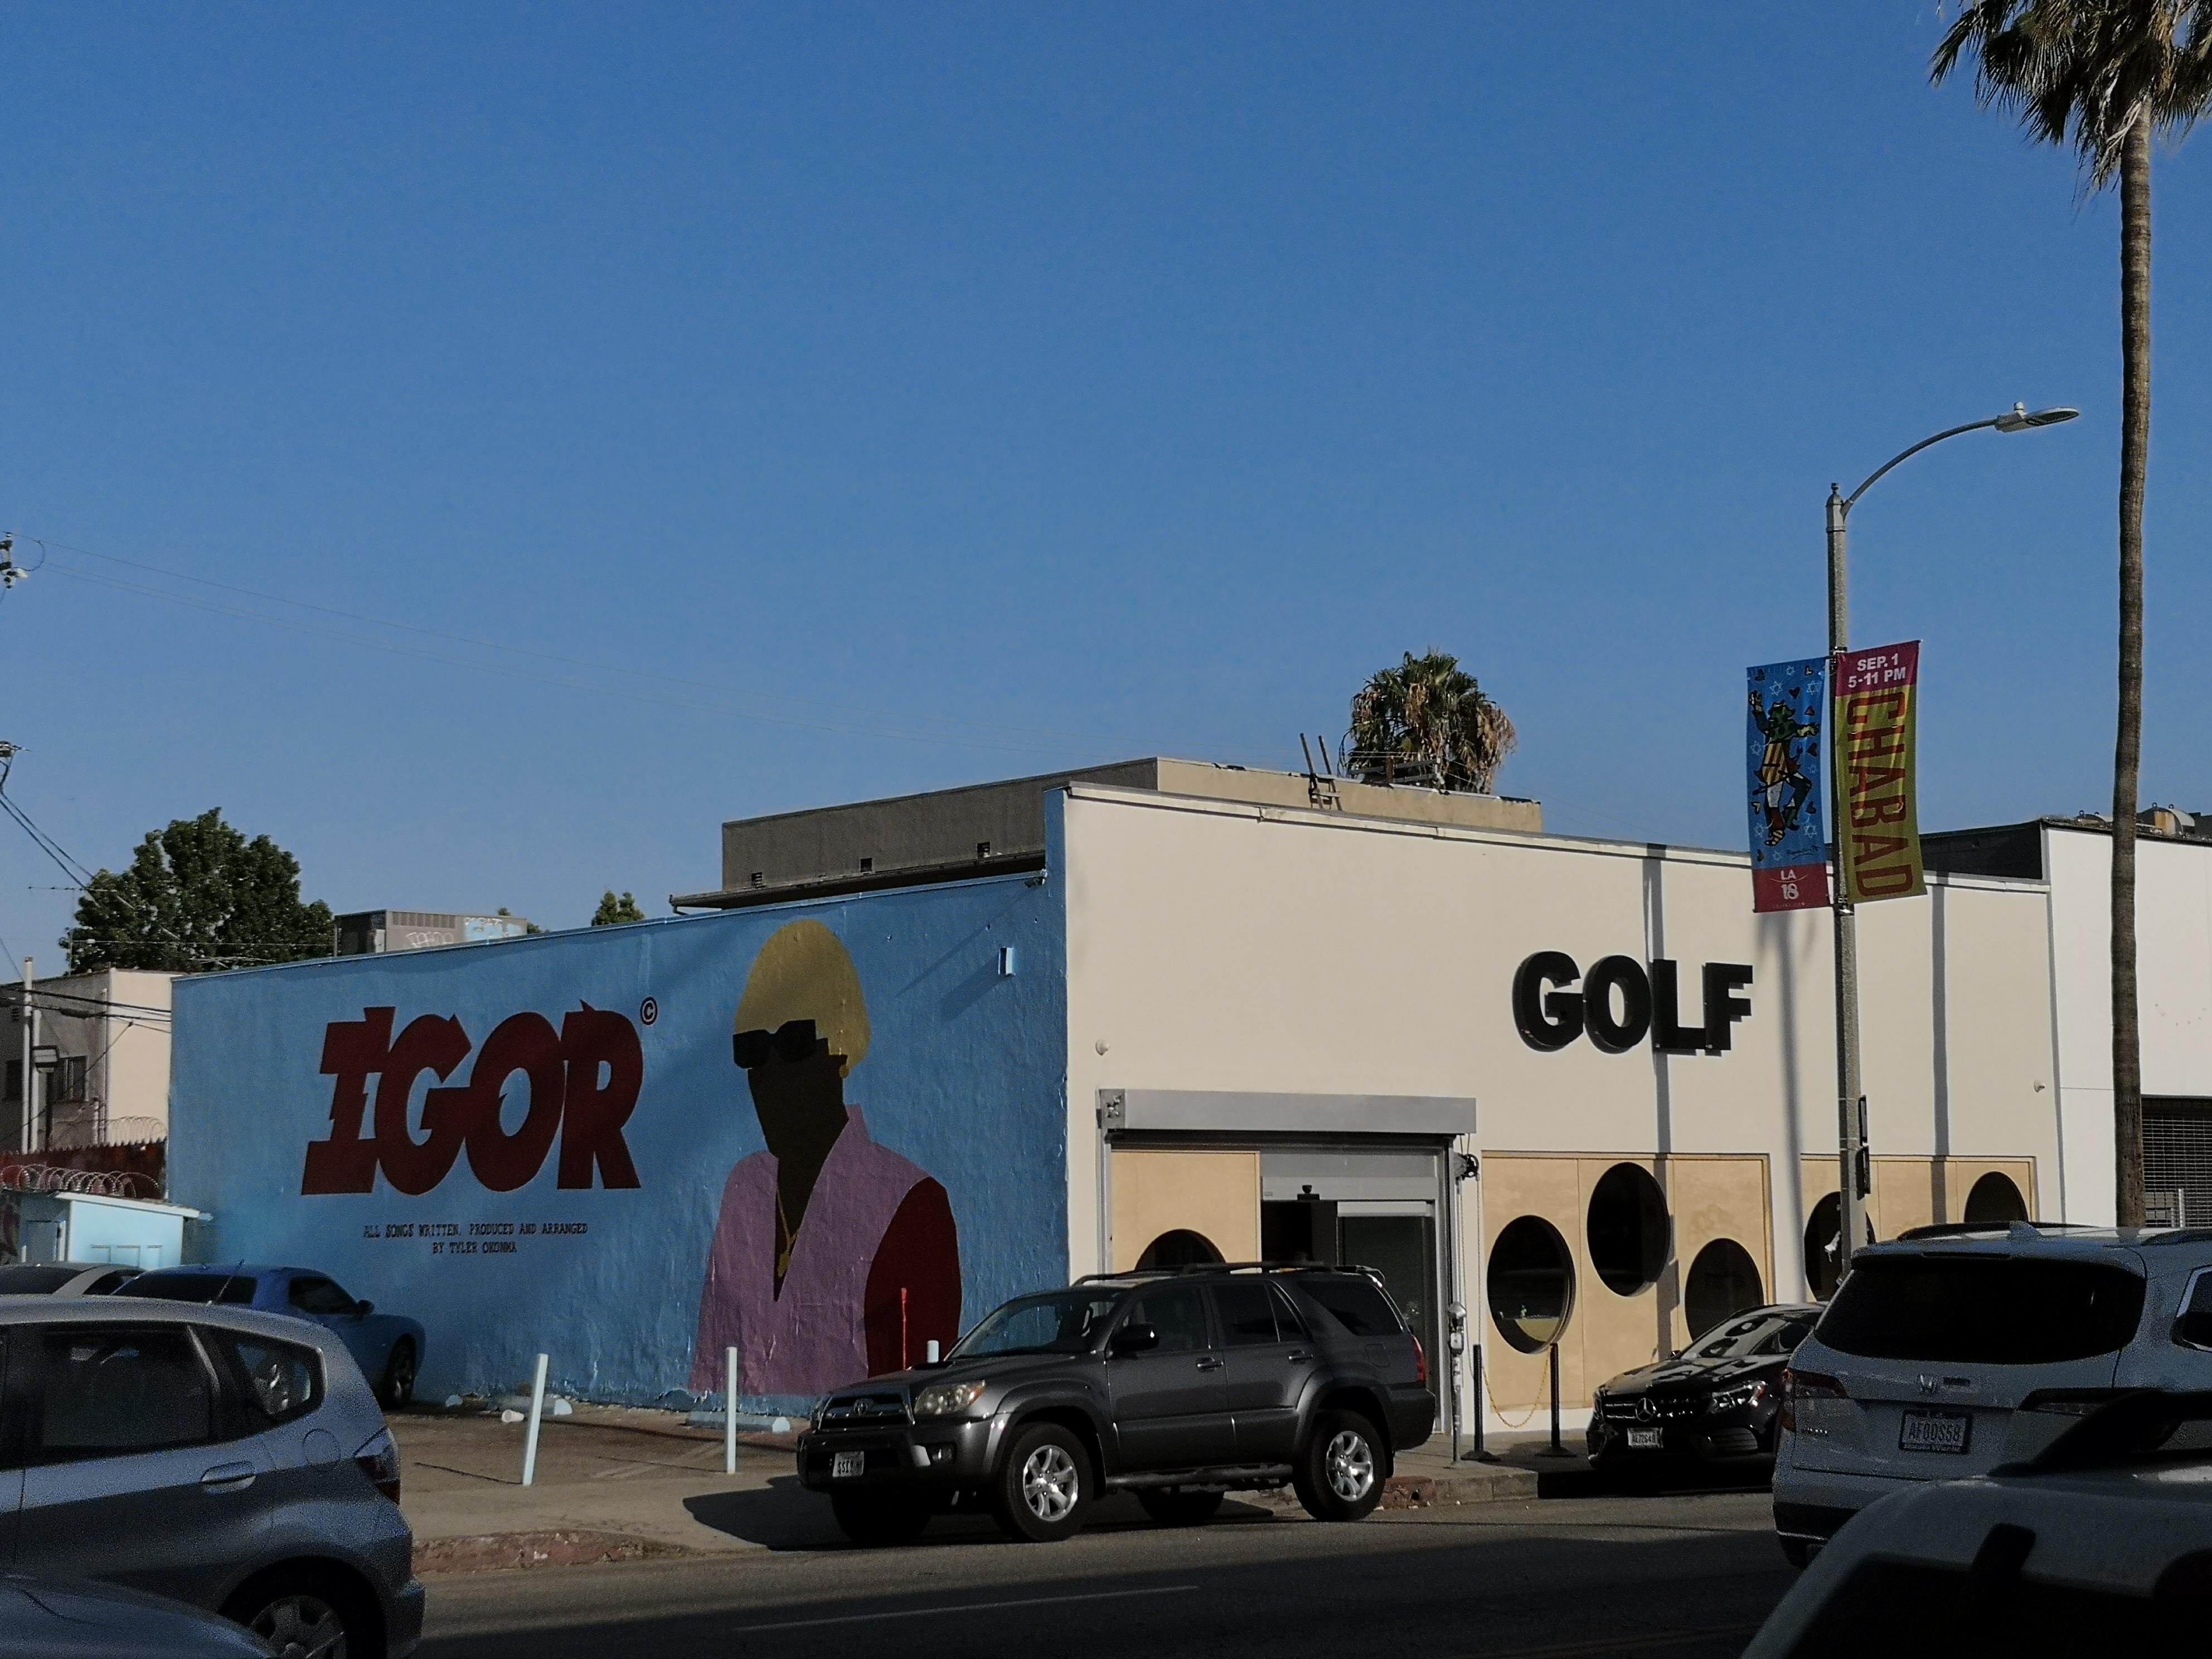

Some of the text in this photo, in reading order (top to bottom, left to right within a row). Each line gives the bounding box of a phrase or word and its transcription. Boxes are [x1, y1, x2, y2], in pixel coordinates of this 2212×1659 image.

[1857, 653, 1898, 671] SEP. 1
[1848, 667, 1906, 688] 5-11 PM
[1846, 691, 1913, 896] CHABAD
[1781, 870, 1797, 880] LA
[1781, 883, 1799, 899] 18
[1512, 951, 1753, 1056] GOLF
[301, 1000, 643, 1195] IGOR
[386, 1223, 414, 1238] SONGS
[469, 1223, 514, 1235] PRODUCED
[519, 1224, 536, 1235] AND
[542, 1223, 588, 1234] ARRANGED
[433, 1242, 444, 1254] BY
[449, 1241, 477, 1254] TYLER
